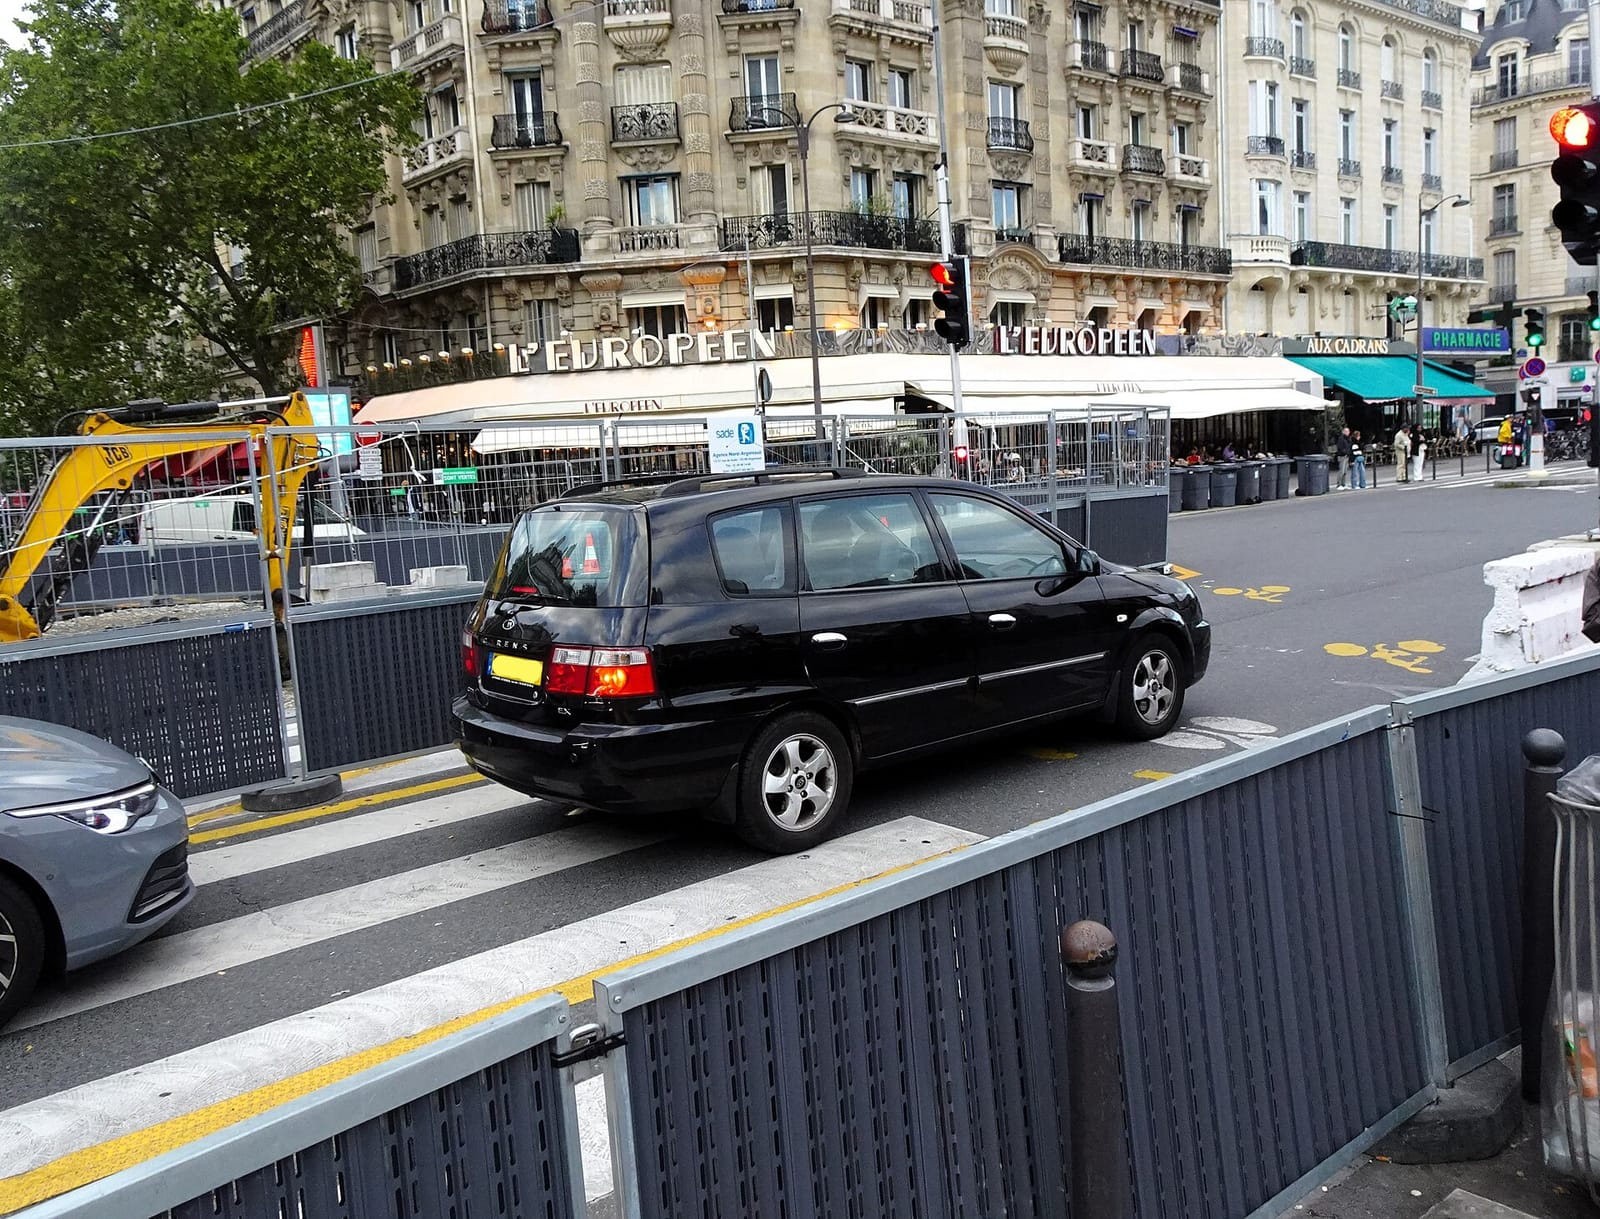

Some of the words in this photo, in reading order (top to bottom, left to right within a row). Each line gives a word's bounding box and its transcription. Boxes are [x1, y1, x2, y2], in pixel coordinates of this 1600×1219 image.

[1000, 325, 1156, 356] L'EUROPEEN
[1306, 338, 1332, 354] AUX
[1334, 338, 1389, 355] CADRANS
[1433, 331, 1502, 348] PHARMACIE
[508, 326, 777, 374] L'EUROPEEN
[716, 428, 734, 439] sade
[102, 446, 129, 465] JCB
[482, 637, 528, 650] CRENS
[557, 707, 572, 716] EX
